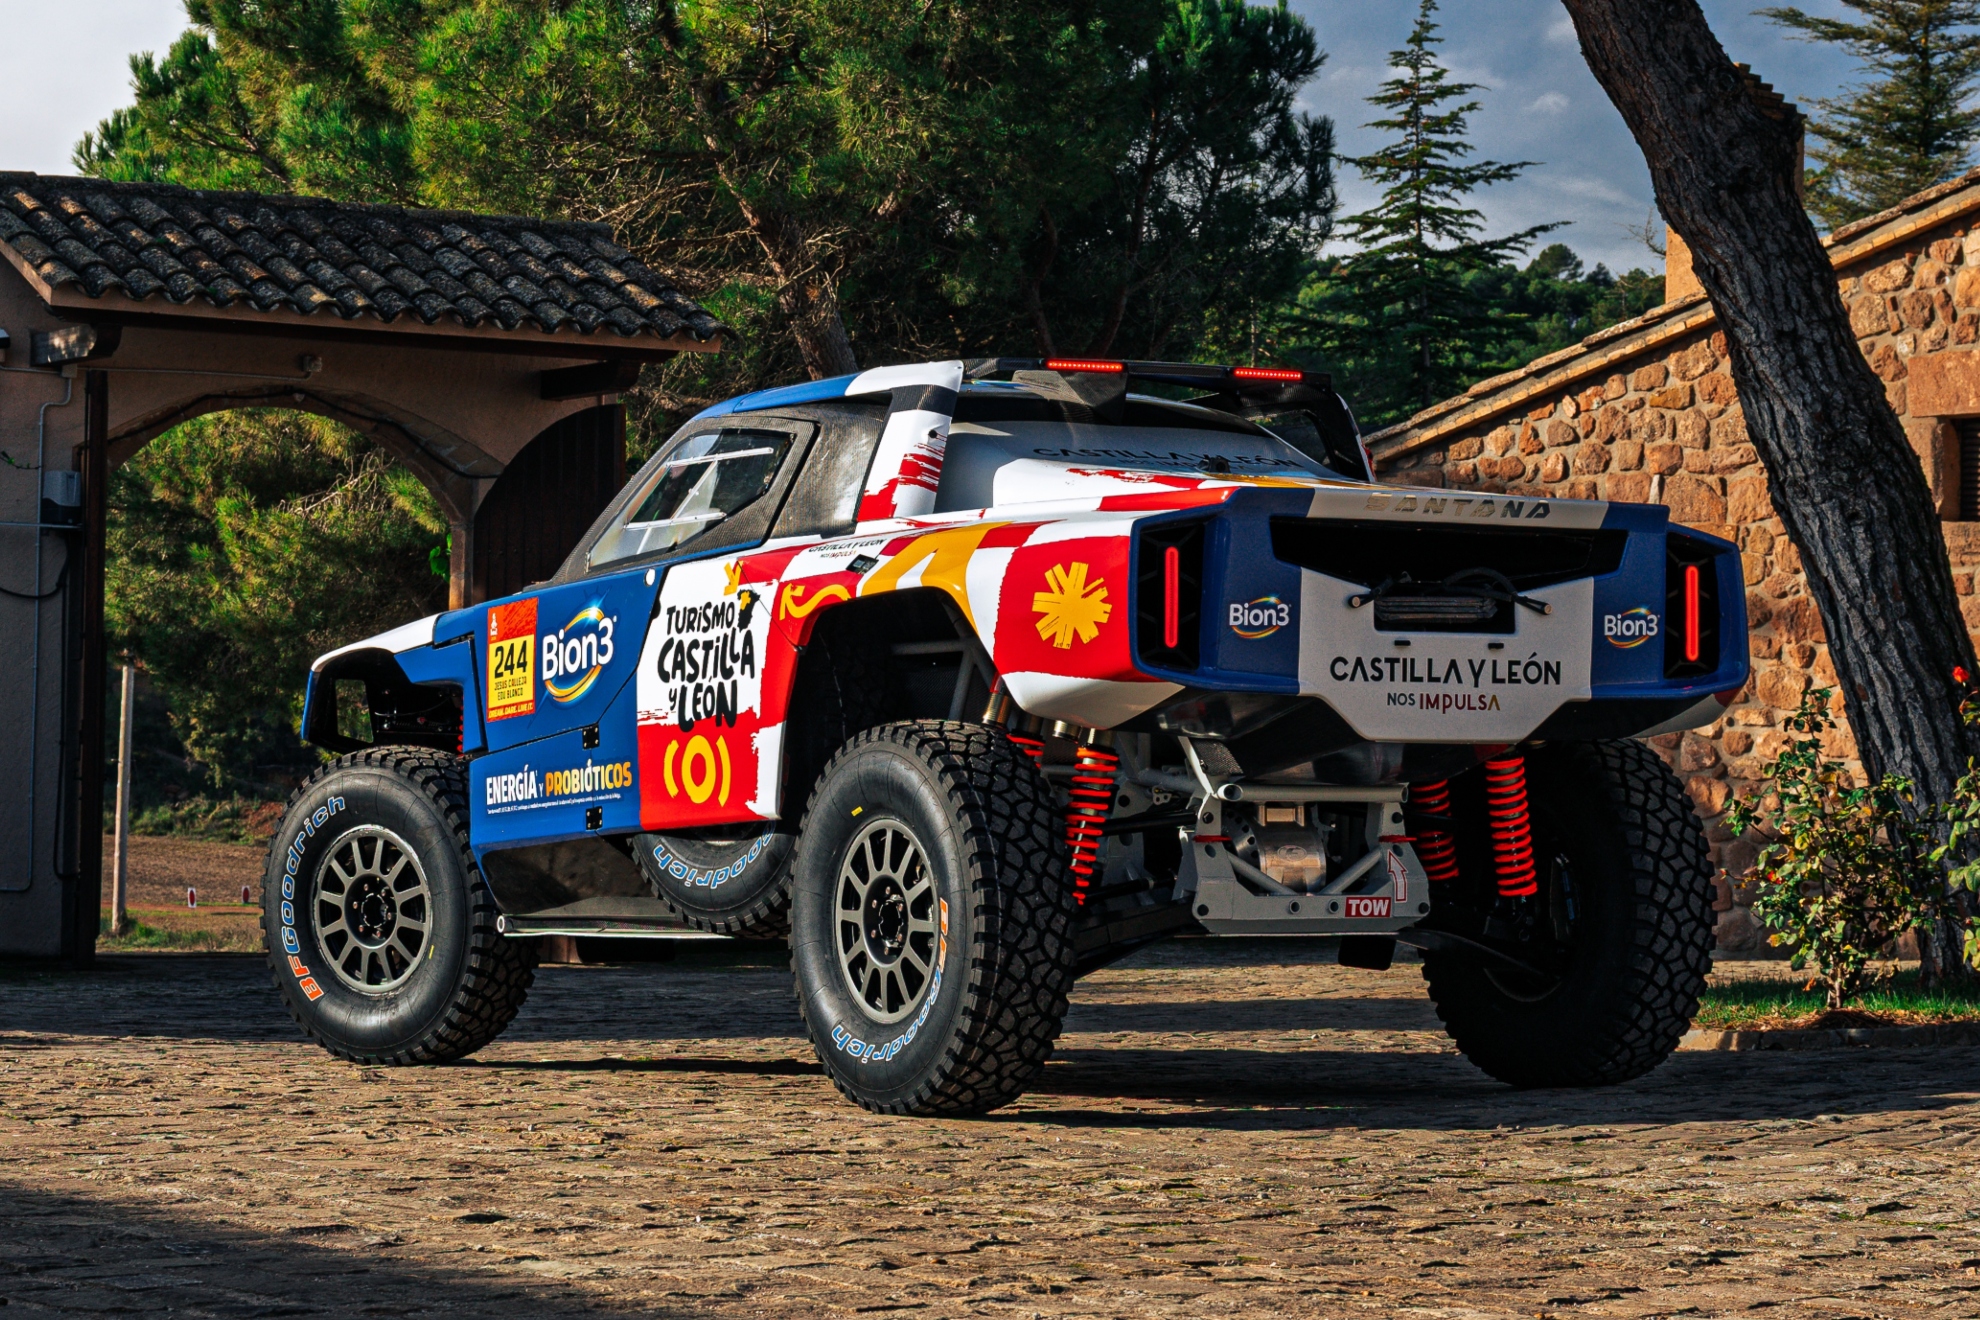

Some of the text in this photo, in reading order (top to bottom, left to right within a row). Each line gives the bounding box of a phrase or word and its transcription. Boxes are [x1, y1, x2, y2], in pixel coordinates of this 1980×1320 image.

[1363, 492, 1551, 519] SANTANA
[1229, 602, 1290, 626] Bion3
[1604, 613, 1658, 636] Bion3
[494, 640, 528, 679] 244
[542, 616, 614, 681] Bion3
[1330, 656, 1463, 683] CASTILLA
[1491, 652, 1562, 685] LEÓN
[677, 676, 738, 733] LEÓN
[1387, 692, 1501, 714] NOS IMPULSA
[545, 758, 633, 797] PROBIÓTICOS
[281, 795, 346, 1001] BFGoodrich
[1348, 899, 1389, 916] TOW
